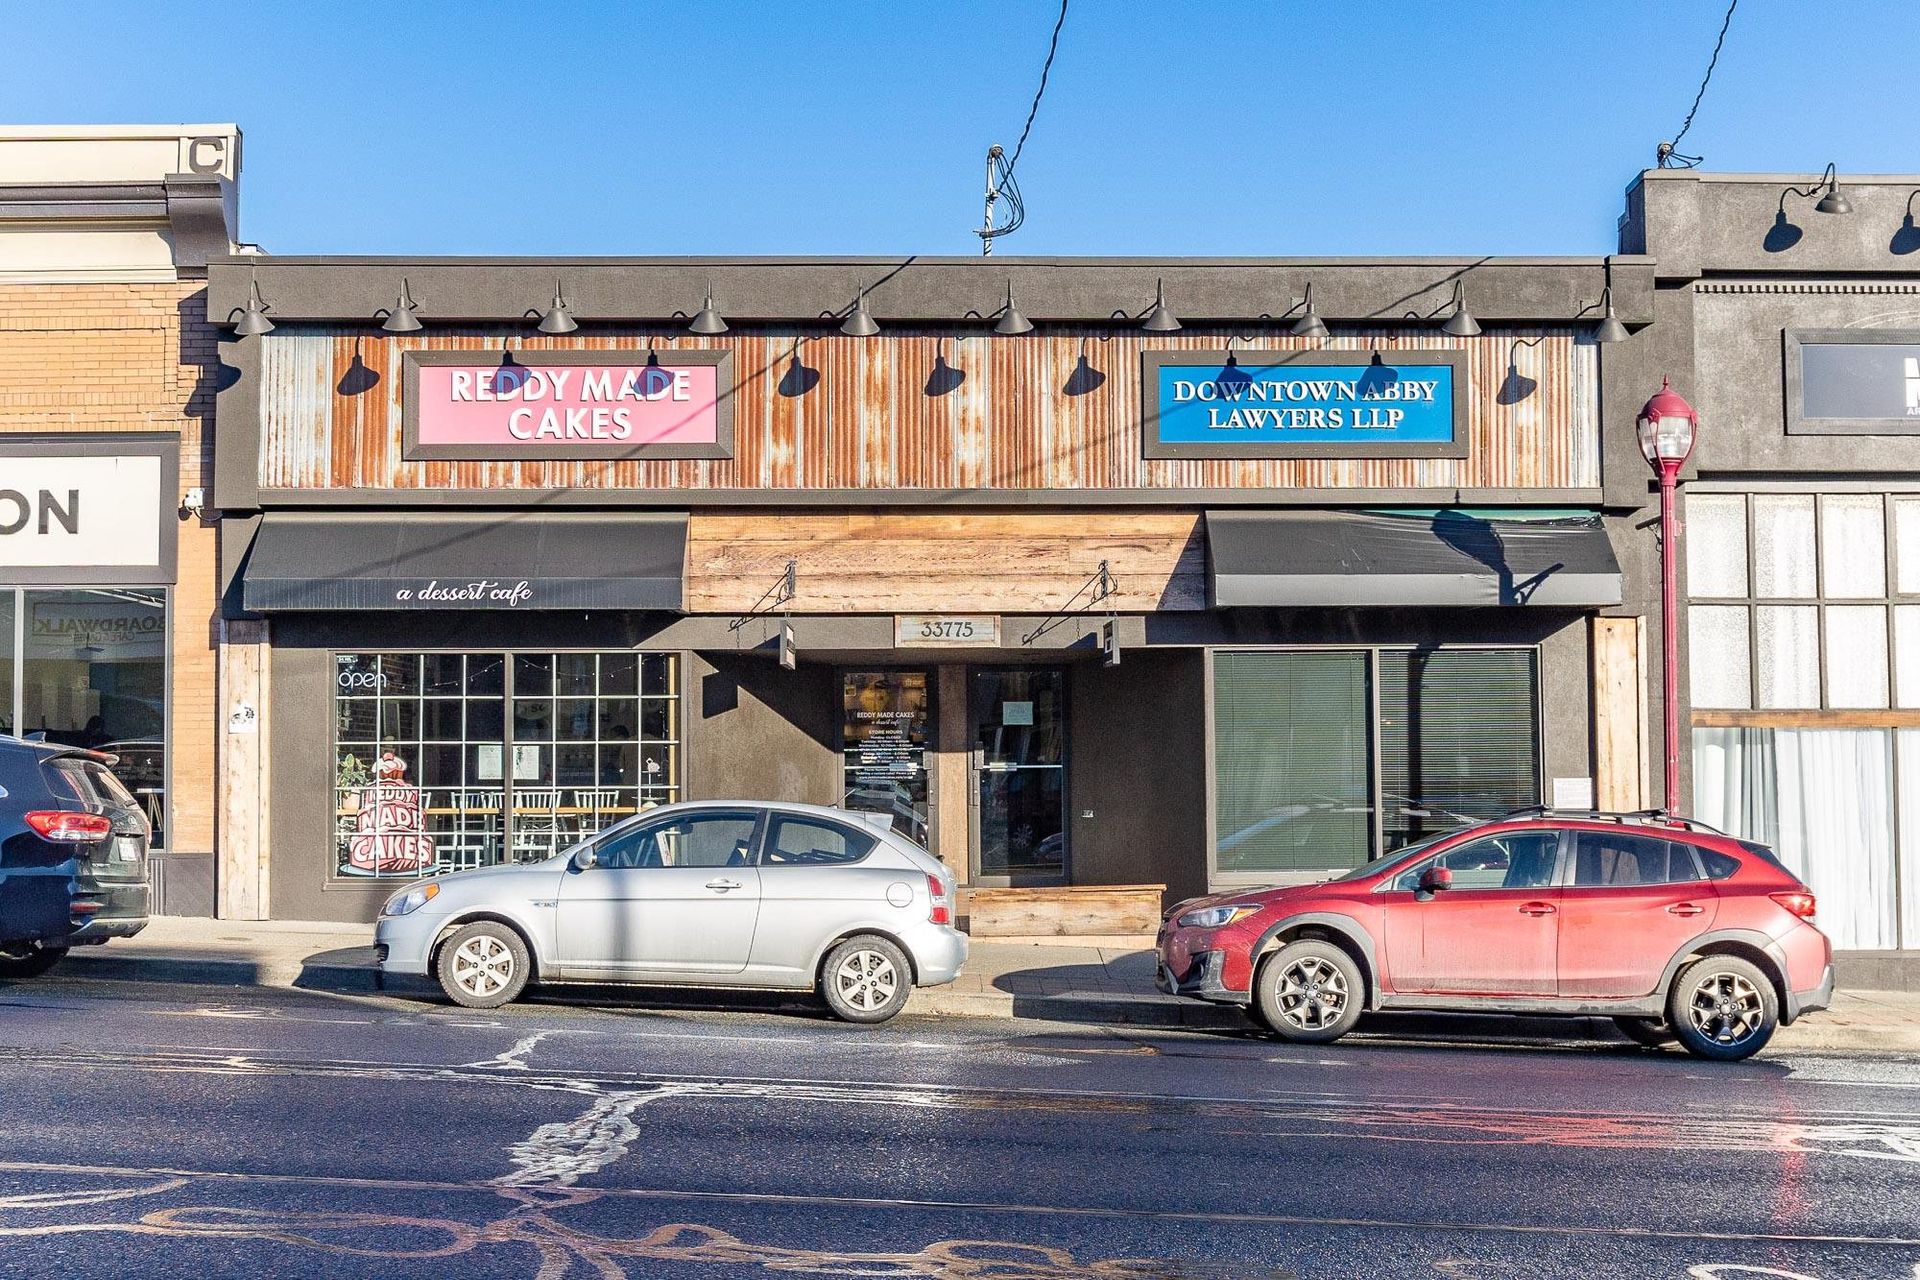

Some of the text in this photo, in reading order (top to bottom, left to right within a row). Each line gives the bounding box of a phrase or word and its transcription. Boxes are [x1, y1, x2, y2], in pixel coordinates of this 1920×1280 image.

[189, 137, 224, 175] C
[450, 369, 692, 402] REDDY MADE
[1172, 380, 1439, 402] DOWNTOWN ABBY
[507, 407, 633, 440] CAKES
[1208, 407, 1405, 430] LAWYERS LLP
[0, 488, 80, 535] ON
[396, 580, 534, 607] a dessert cafe
[920, 621, 974, 638] 33775
[338, 672, 387, 690] open
[353, 835, 432, 864] CAKES
